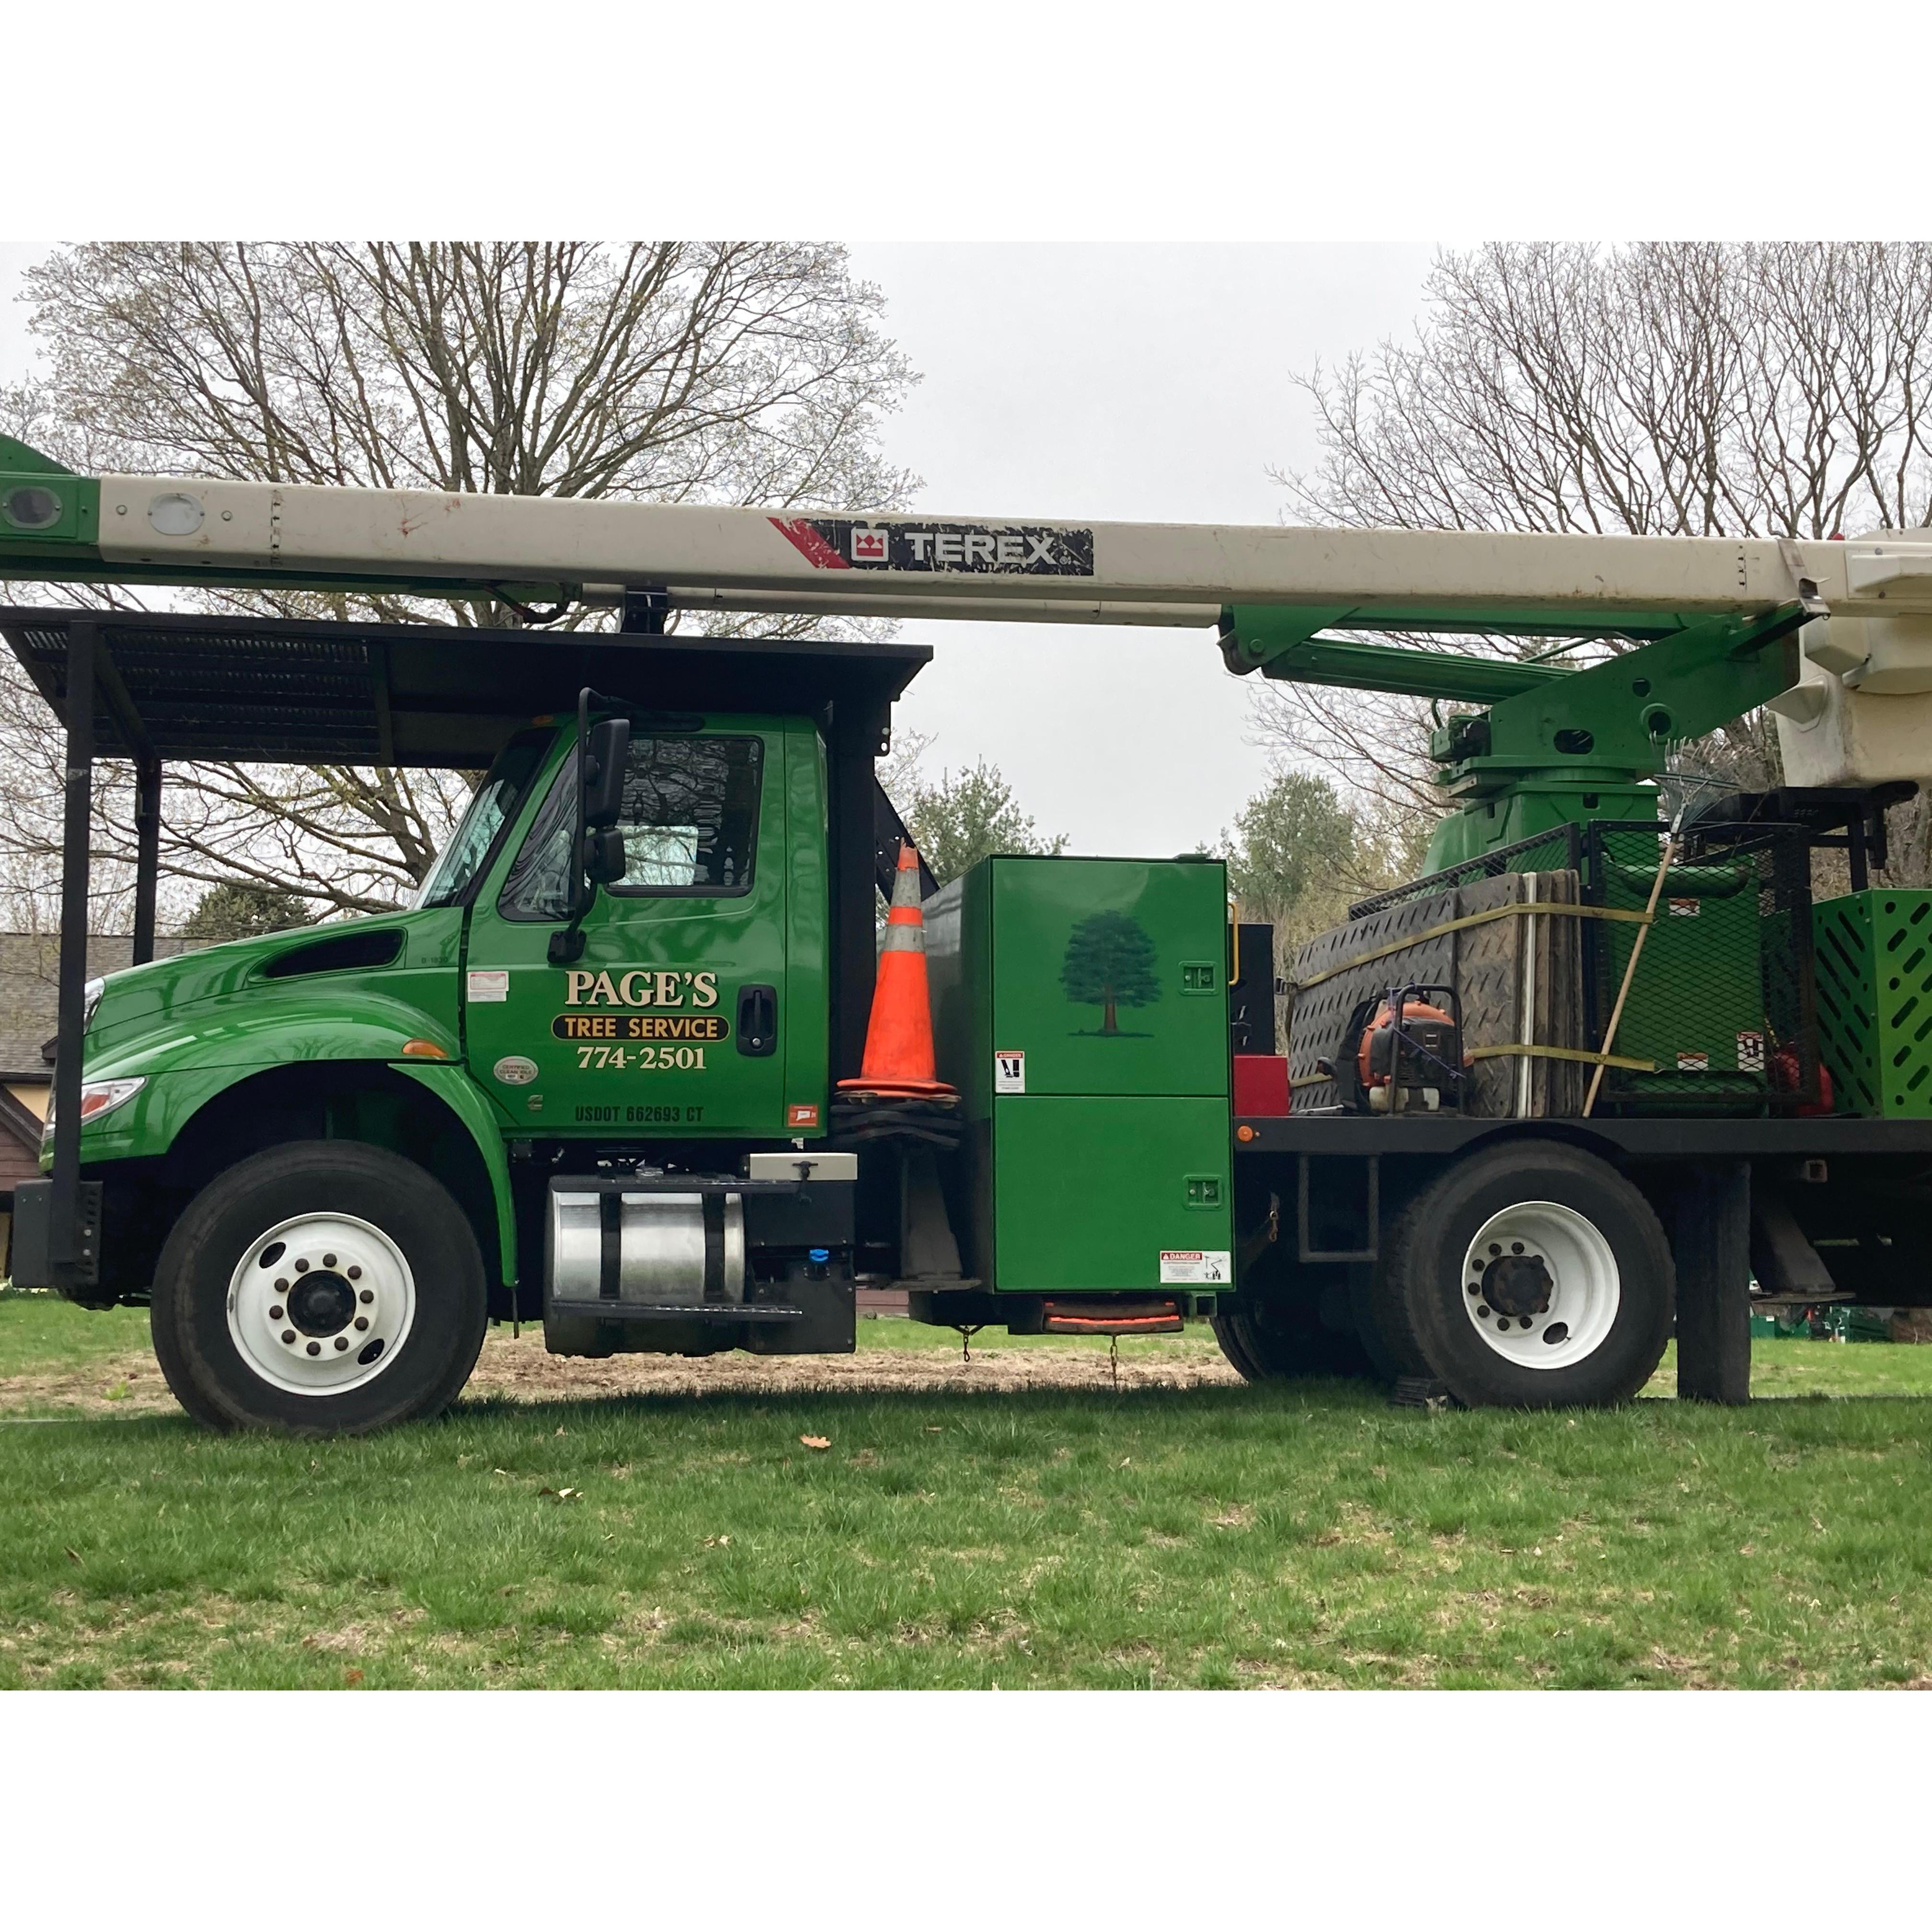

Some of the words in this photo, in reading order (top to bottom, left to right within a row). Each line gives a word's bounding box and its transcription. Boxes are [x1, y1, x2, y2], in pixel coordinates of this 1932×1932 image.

[904, 532, 1058, 565] TEREX
[564, 970, 718, 1008] PAGE'S
[564, 1018, 616, 1037] TREE
[629, 1018, 717, 1038] SERVICE
[577, 1046, 707, 1070] 774-2501
[575, 1106, 621, 1122] USDOT
[626, 1106, 680, 1122] 662693
[686, 1106, 704, 1122] CT
